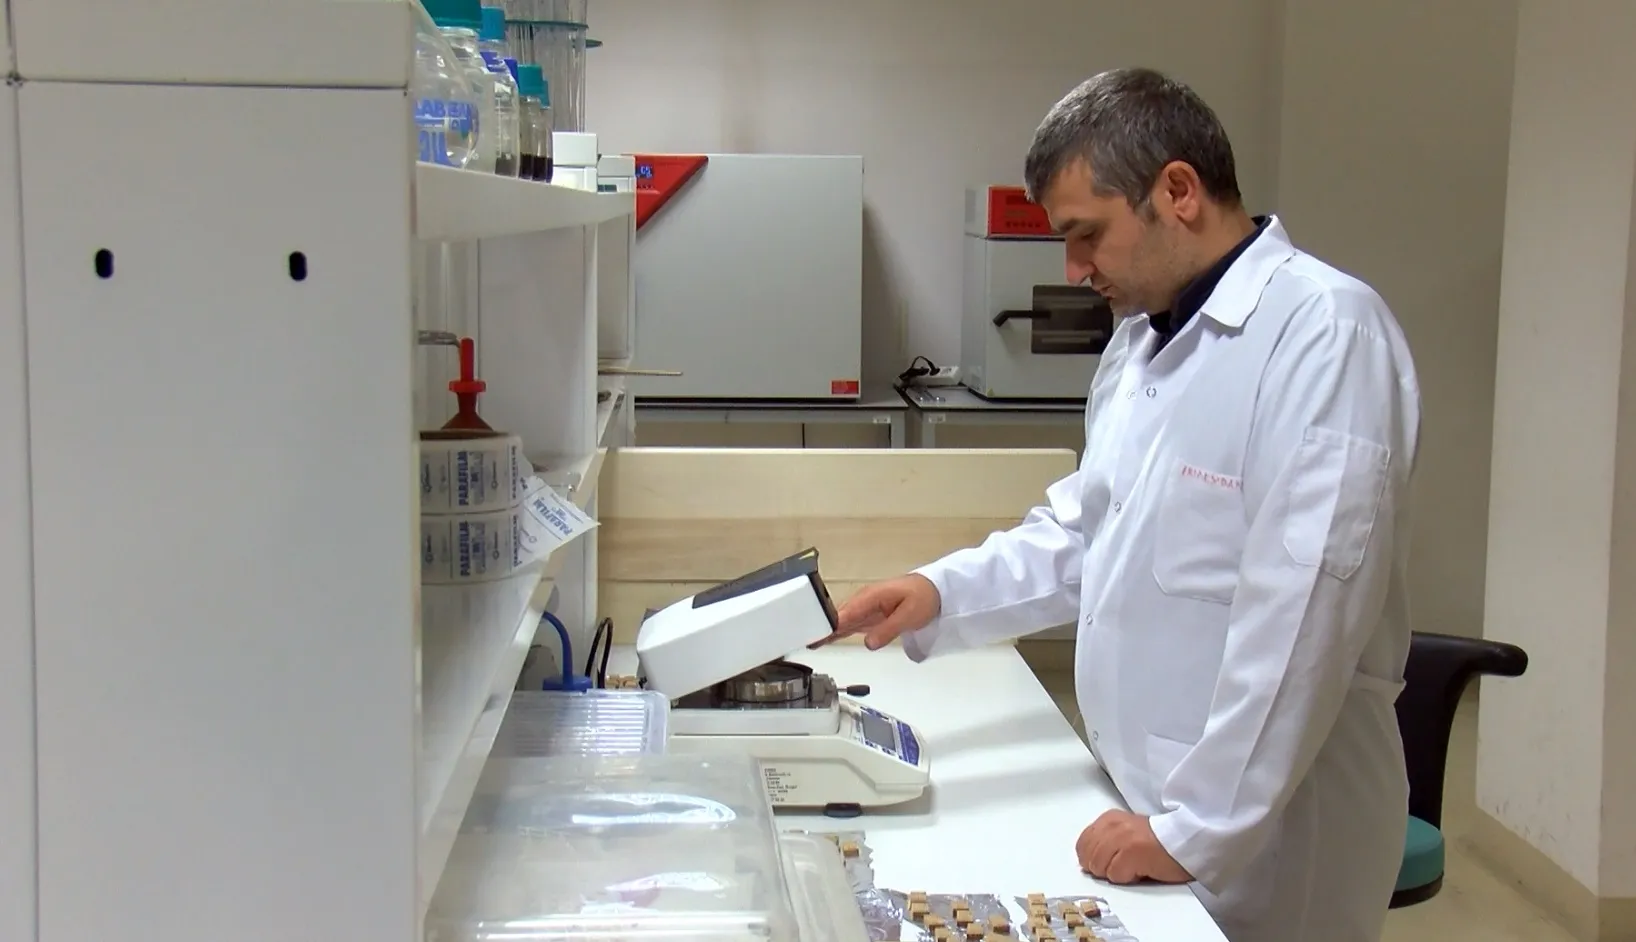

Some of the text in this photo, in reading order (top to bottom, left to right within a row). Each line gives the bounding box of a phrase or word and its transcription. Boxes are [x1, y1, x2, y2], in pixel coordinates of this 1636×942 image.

[457, 451, 469, 506] PARAFILM
[533, 498, 573, 536] PARAFILM
[459, 520, 471, 577] PARAFILM
